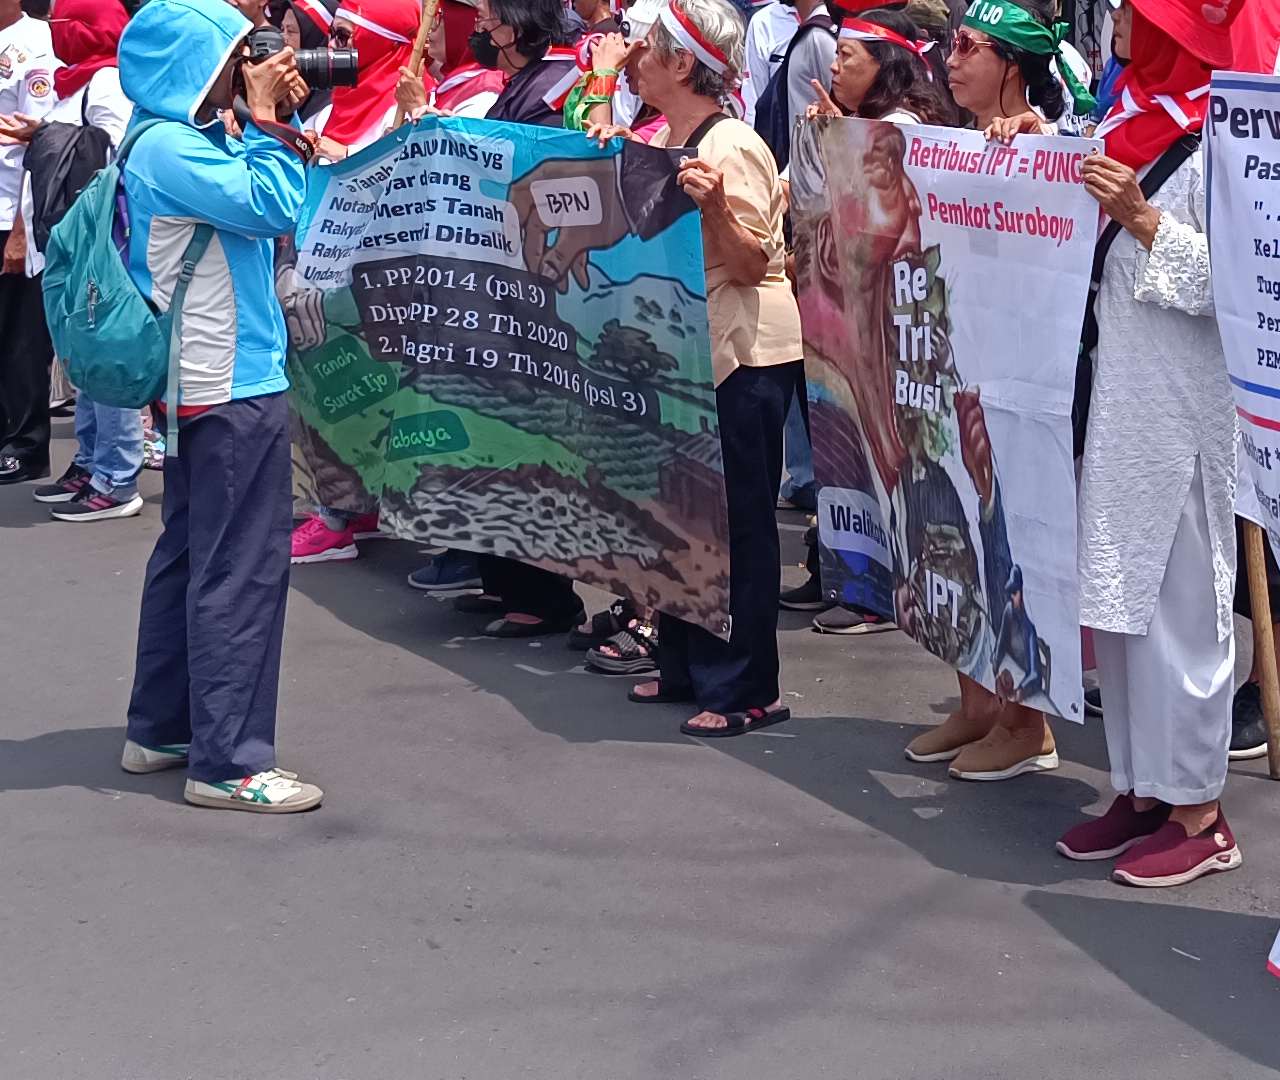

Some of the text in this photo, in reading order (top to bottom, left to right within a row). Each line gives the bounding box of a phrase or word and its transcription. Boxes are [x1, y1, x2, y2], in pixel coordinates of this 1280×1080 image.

[483, 151, 504, 170] yg
[908, 138, 989, 174] Retribusi
[986, 147, 1018, 177] IPT
[442, 197, 504, 223] Tanah
[545, 191, 590, 214] BPN
[927, 193, 1074, 247] Pemkot Suroboyo
[436, 224, 513, 254] Dibalik
[894, 261, 927, 306] Re
[445, 307, 479, 329] 28
[489, 314, 523, 337] Th
[528, 321, 569, 351] 2020
[894, 312, 931, 361] Tri
[316, 347, 357, 378] Tanah
[465, 346, 499, 369] 19
[508, 352, 538, 376] Th
[543, 361, 580, 395] 2016
[584, 379, 617, 408] (psl
[622, 390, 647, 416] 3)
[895, 370, 941, 412] Busi
[925, 569, 962, 627] IPT
